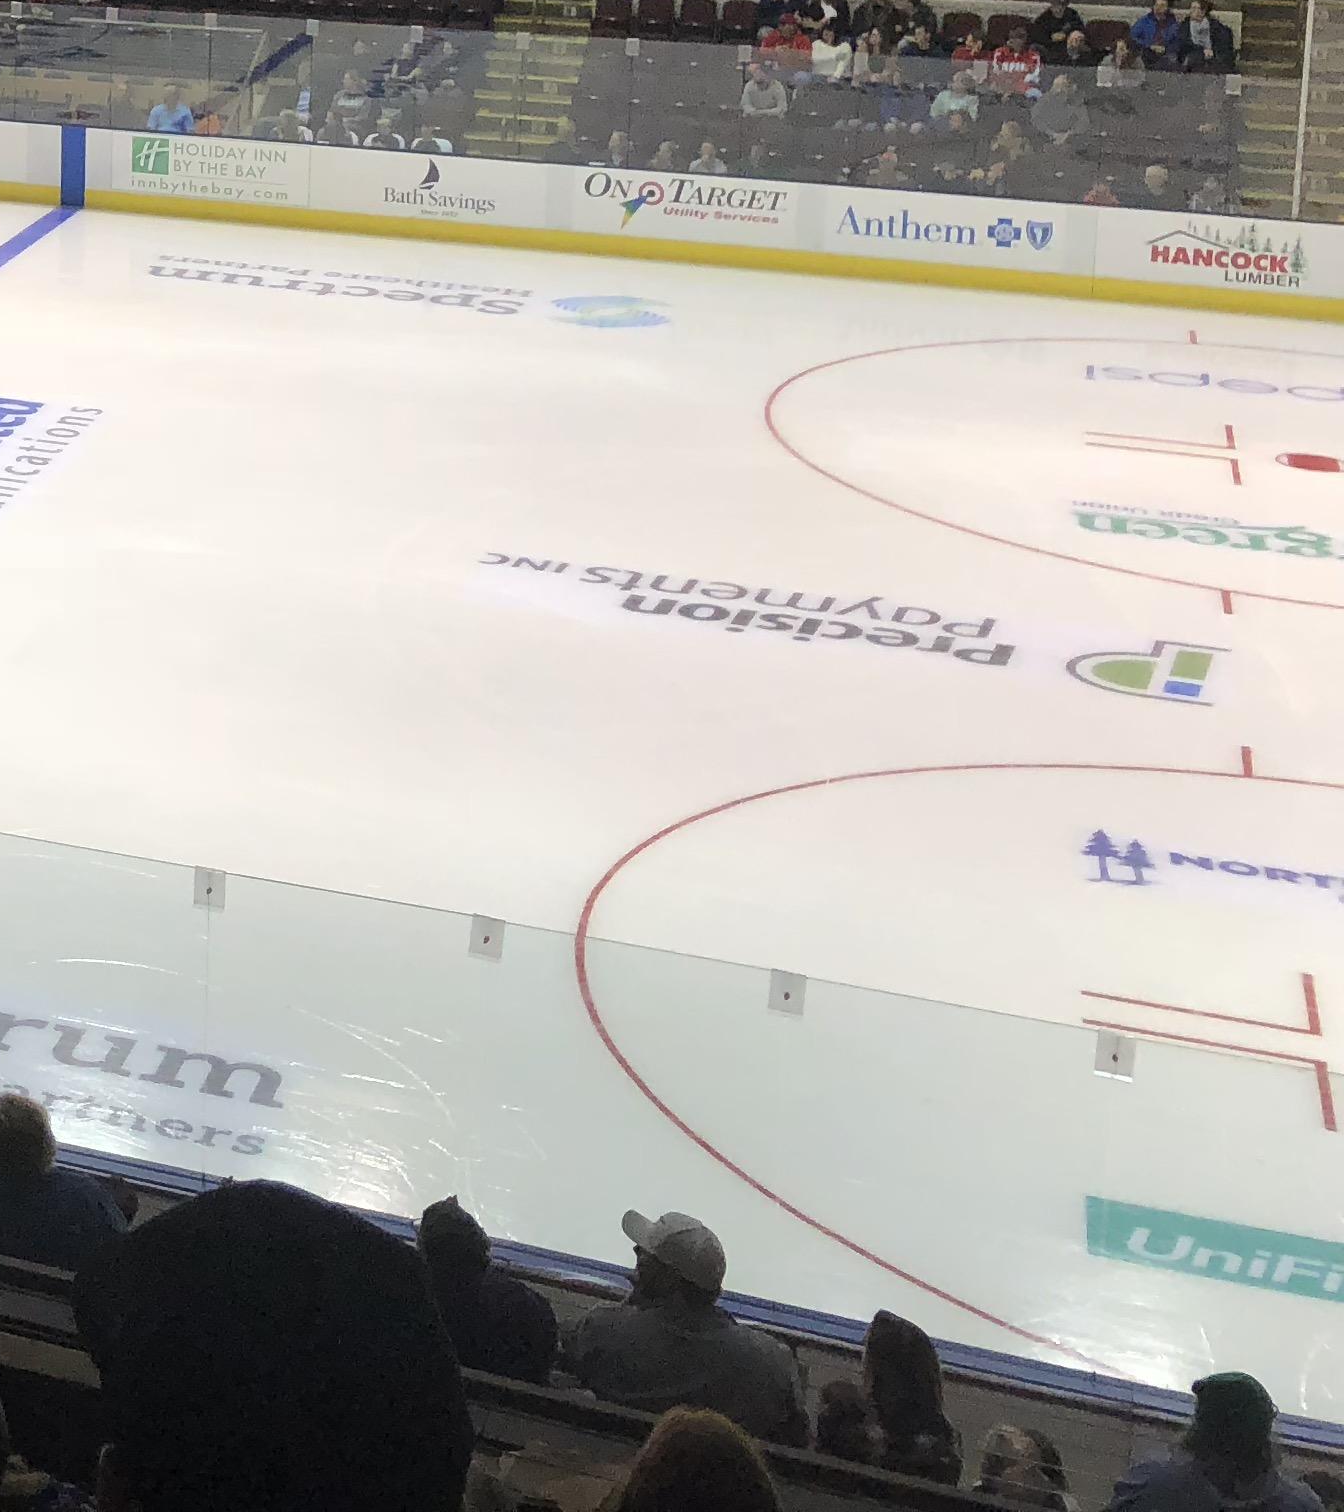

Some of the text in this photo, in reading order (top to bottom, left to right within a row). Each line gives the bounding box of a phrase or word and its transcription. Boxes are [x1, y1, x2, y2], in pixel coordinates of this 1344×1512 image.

[173, 142, 288, 164] HOLIDAY INN
[173, 159, 267, 179] BY THE BAY
[131, 177, 288, 200] innbythebay.com
[383, 187, 497, 215] Bath Savings
[583, 172, 788, 212] ON TARGET
[663, 205, 780, 225] Utility Services
[836, 205, 977, 246] Anthem
[1150, 244, 1289, 274] HANCOCK
[149, 264, 525, 316] Spectrum
[1224, 271, 1301, 288] LUMBER
[1169, 851, 1344, 890] NORT
[1128, 1226, 1344, 1295] UniFi
